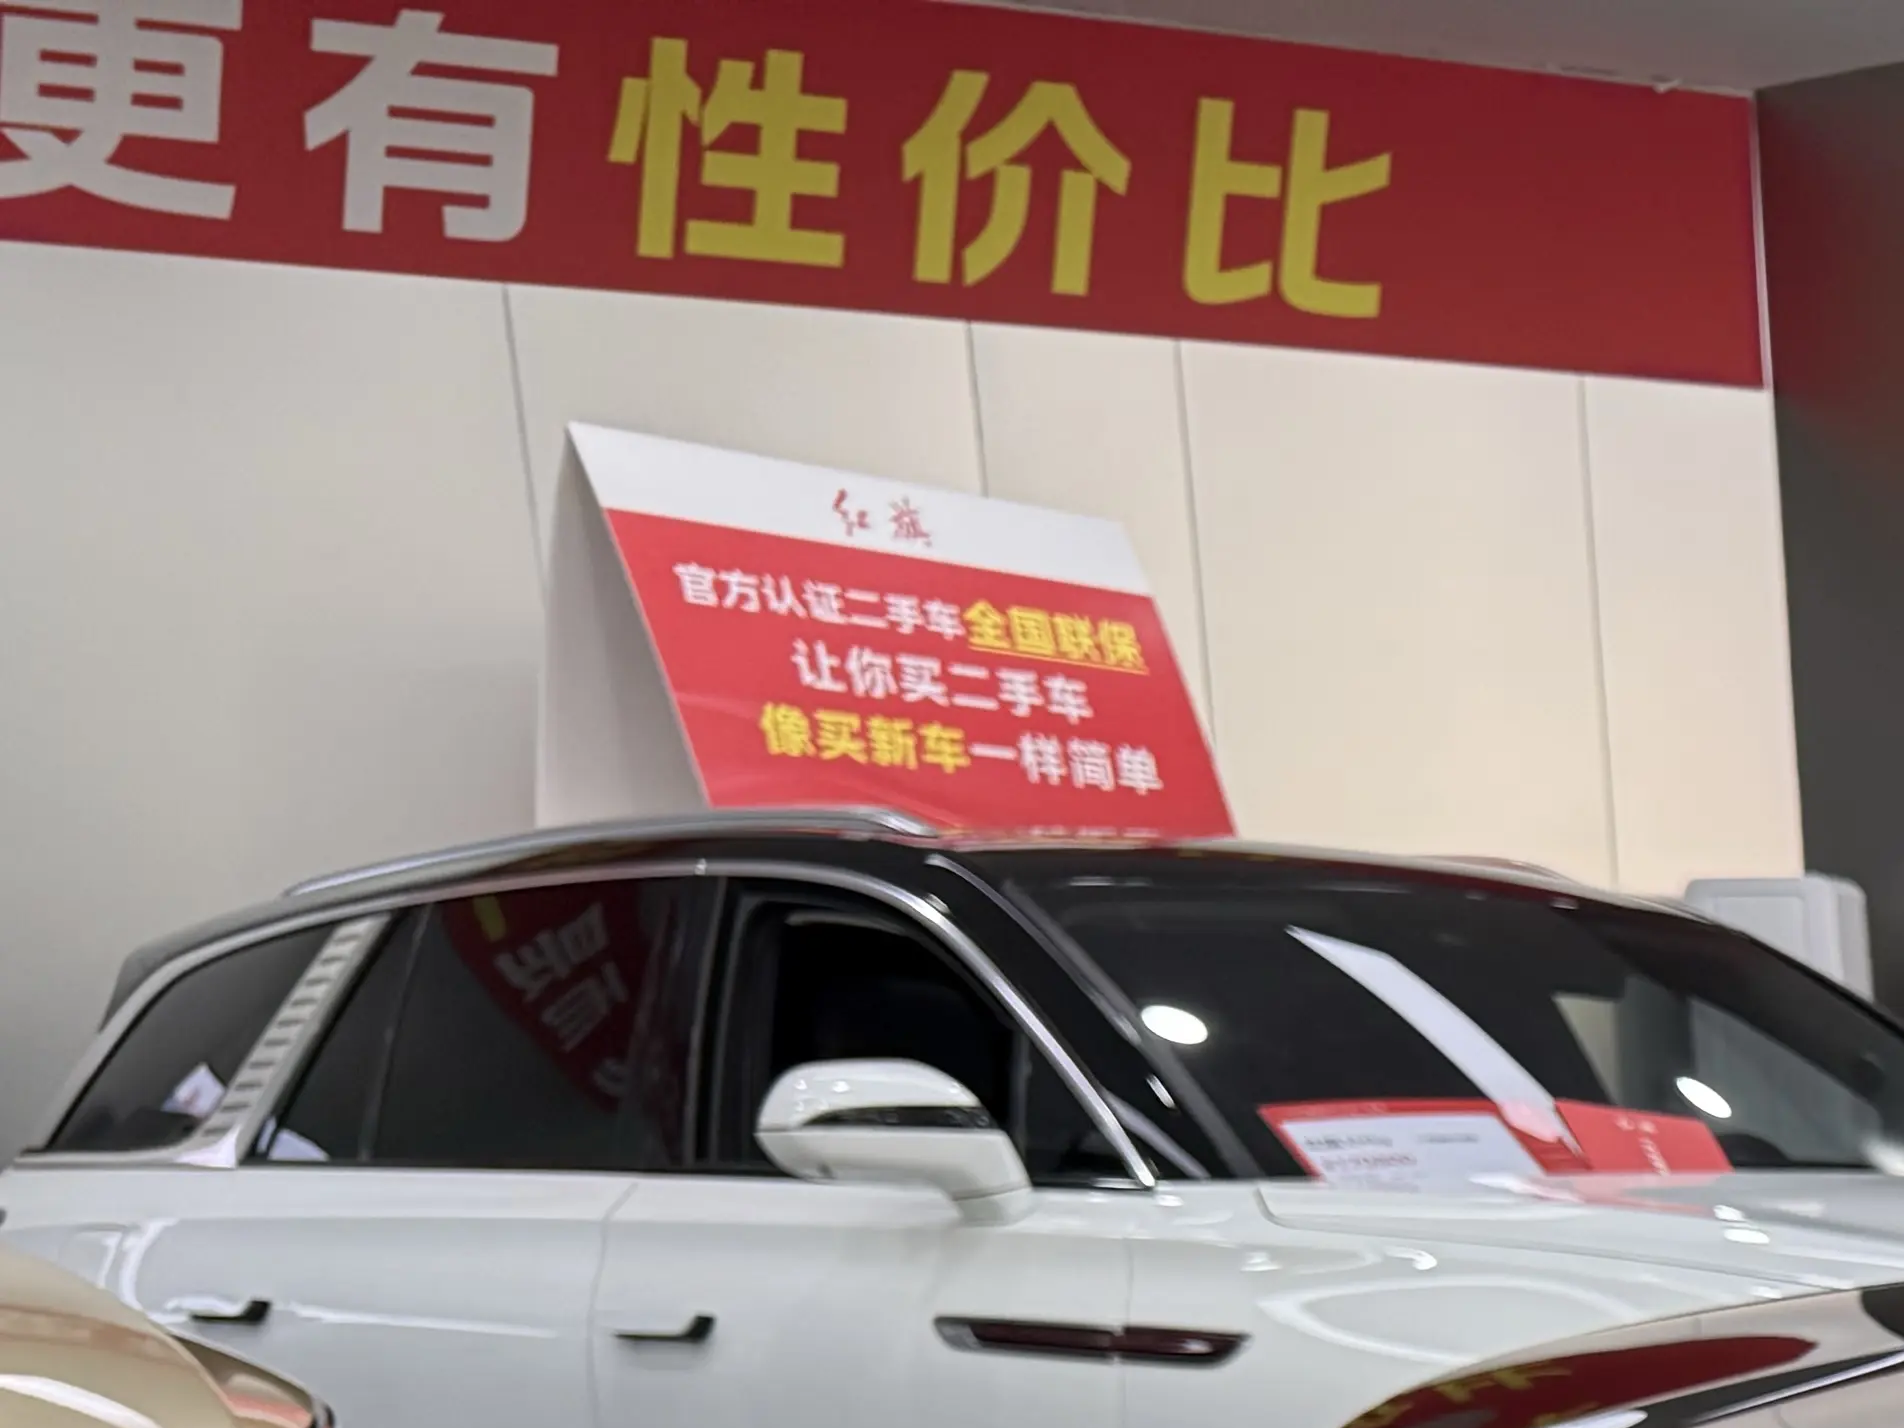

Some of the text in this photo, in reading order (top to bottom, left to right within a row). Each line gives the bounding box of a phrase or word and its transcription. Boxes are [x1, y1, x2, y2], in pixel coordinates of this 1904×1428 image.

[0, 0, 1393, 319] 更有性价比
[833, 488, 932, 547] 红旗
[792, 638, 1093, 725] 让你买二手车
[760, 701, 1163, 796] 像买新车一样简单
